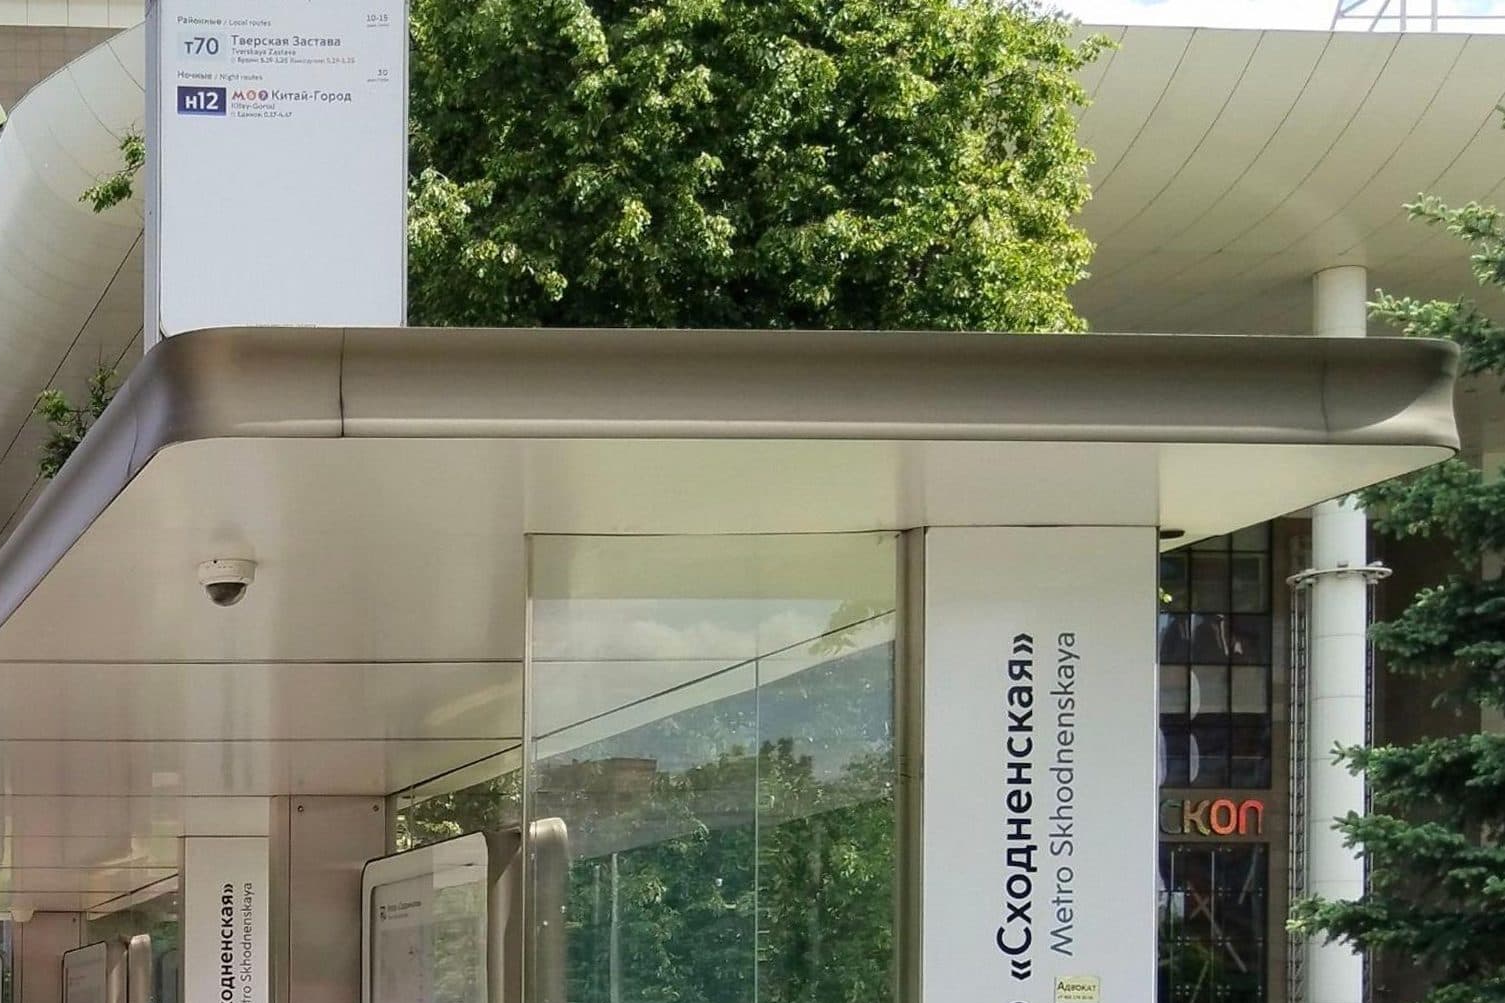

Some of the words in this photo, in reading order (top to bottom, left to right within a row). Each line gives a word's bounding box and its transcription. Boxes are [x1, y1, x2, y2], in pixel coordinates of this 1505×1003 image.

[231, 35, 290, 48] Тверская
[292, 36, 341, 47] Застава
[271, 89, 352, 102] Китай-Город
[1050, 631, 1081, 856] Skhodnenskaya
[997, 632, 1037, 980] «Сходненская»
[240, 882, 254, 982] Skhodnenskaya
[1051, 866, 1075, 957] Metro
